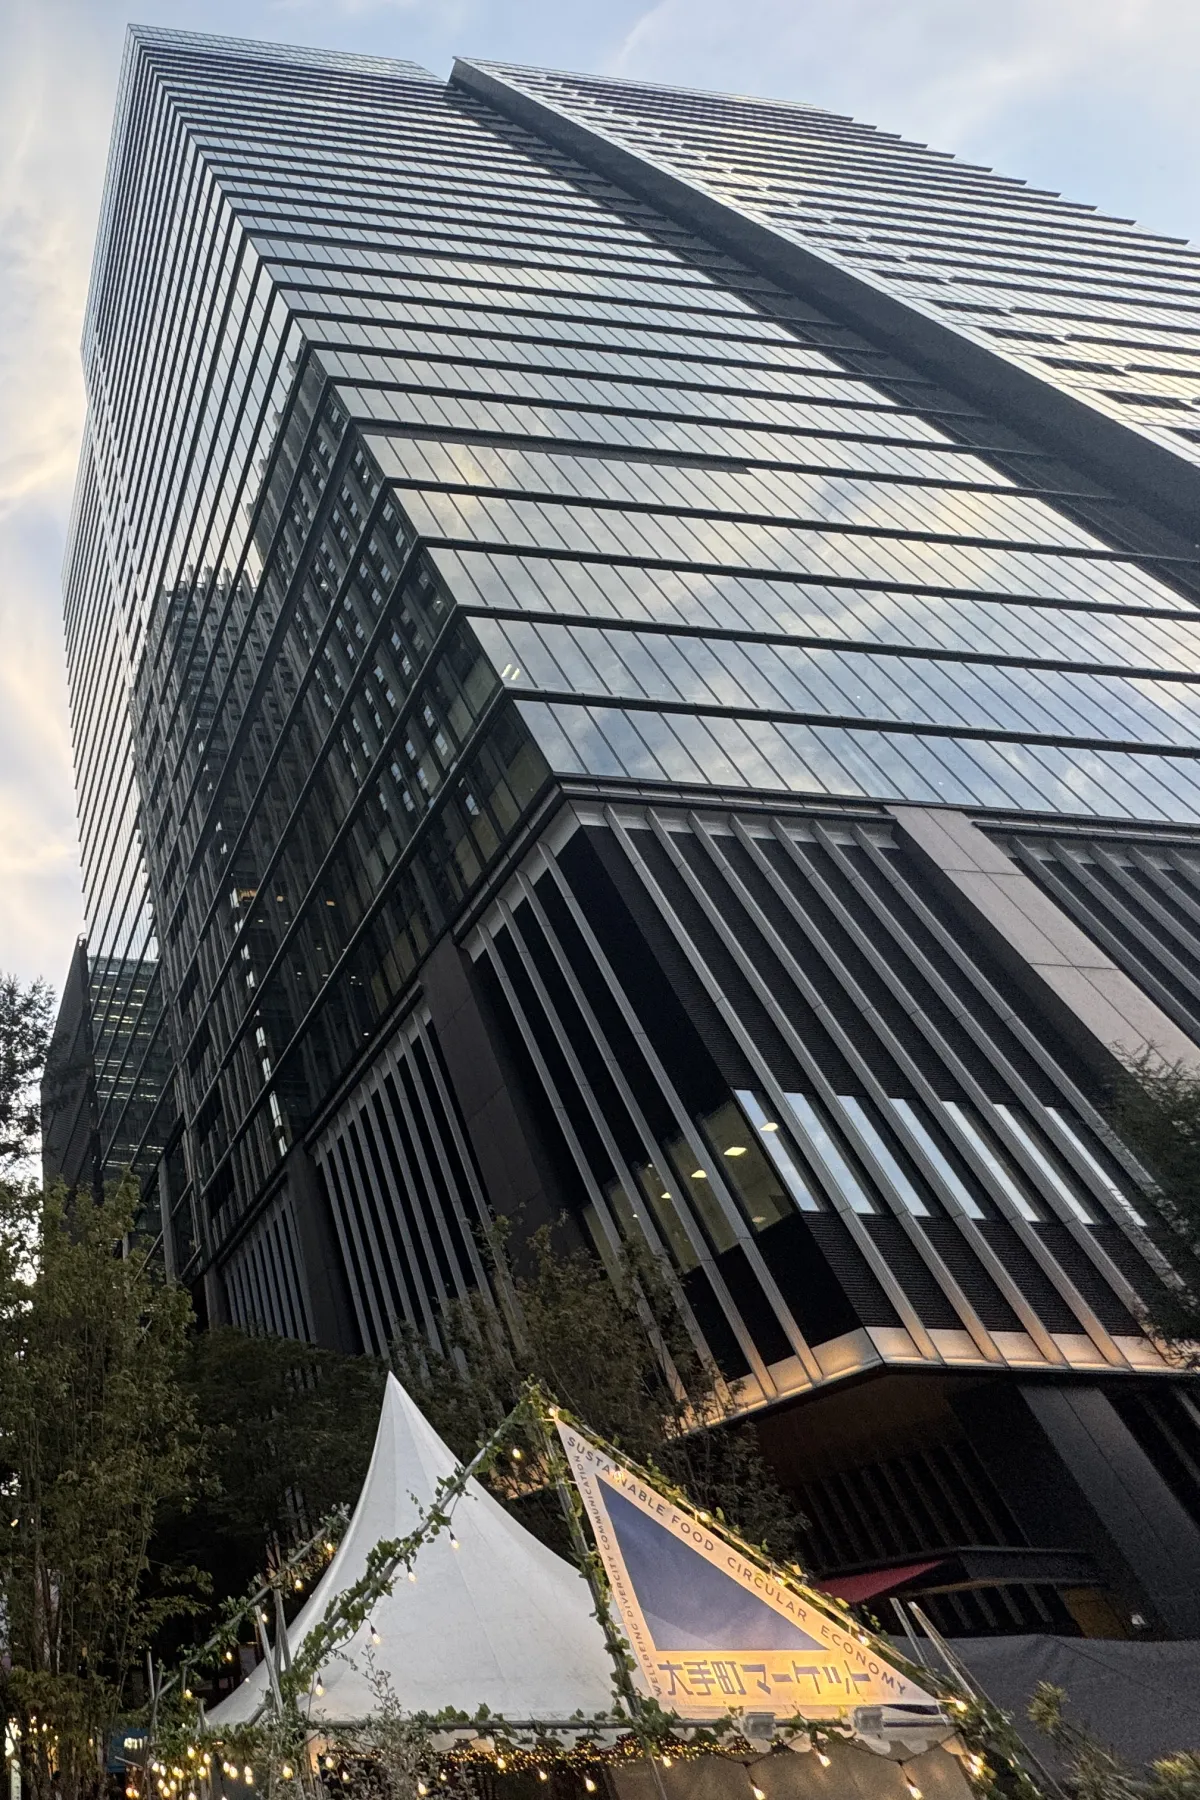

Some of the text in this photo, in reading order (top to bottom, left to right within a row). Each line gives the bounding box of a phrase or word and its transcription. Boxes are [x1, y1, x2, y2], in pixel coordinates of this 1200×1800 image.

[567, 1436, 906, 1695] SUSTANABLE FOOD CIRCULAR ECONOMY
[574, 1455, 662, 1697] WELLBEING DIVERCITY COMMUNICATION
[657, 1660, 871, 1695] 大手町マーケット
